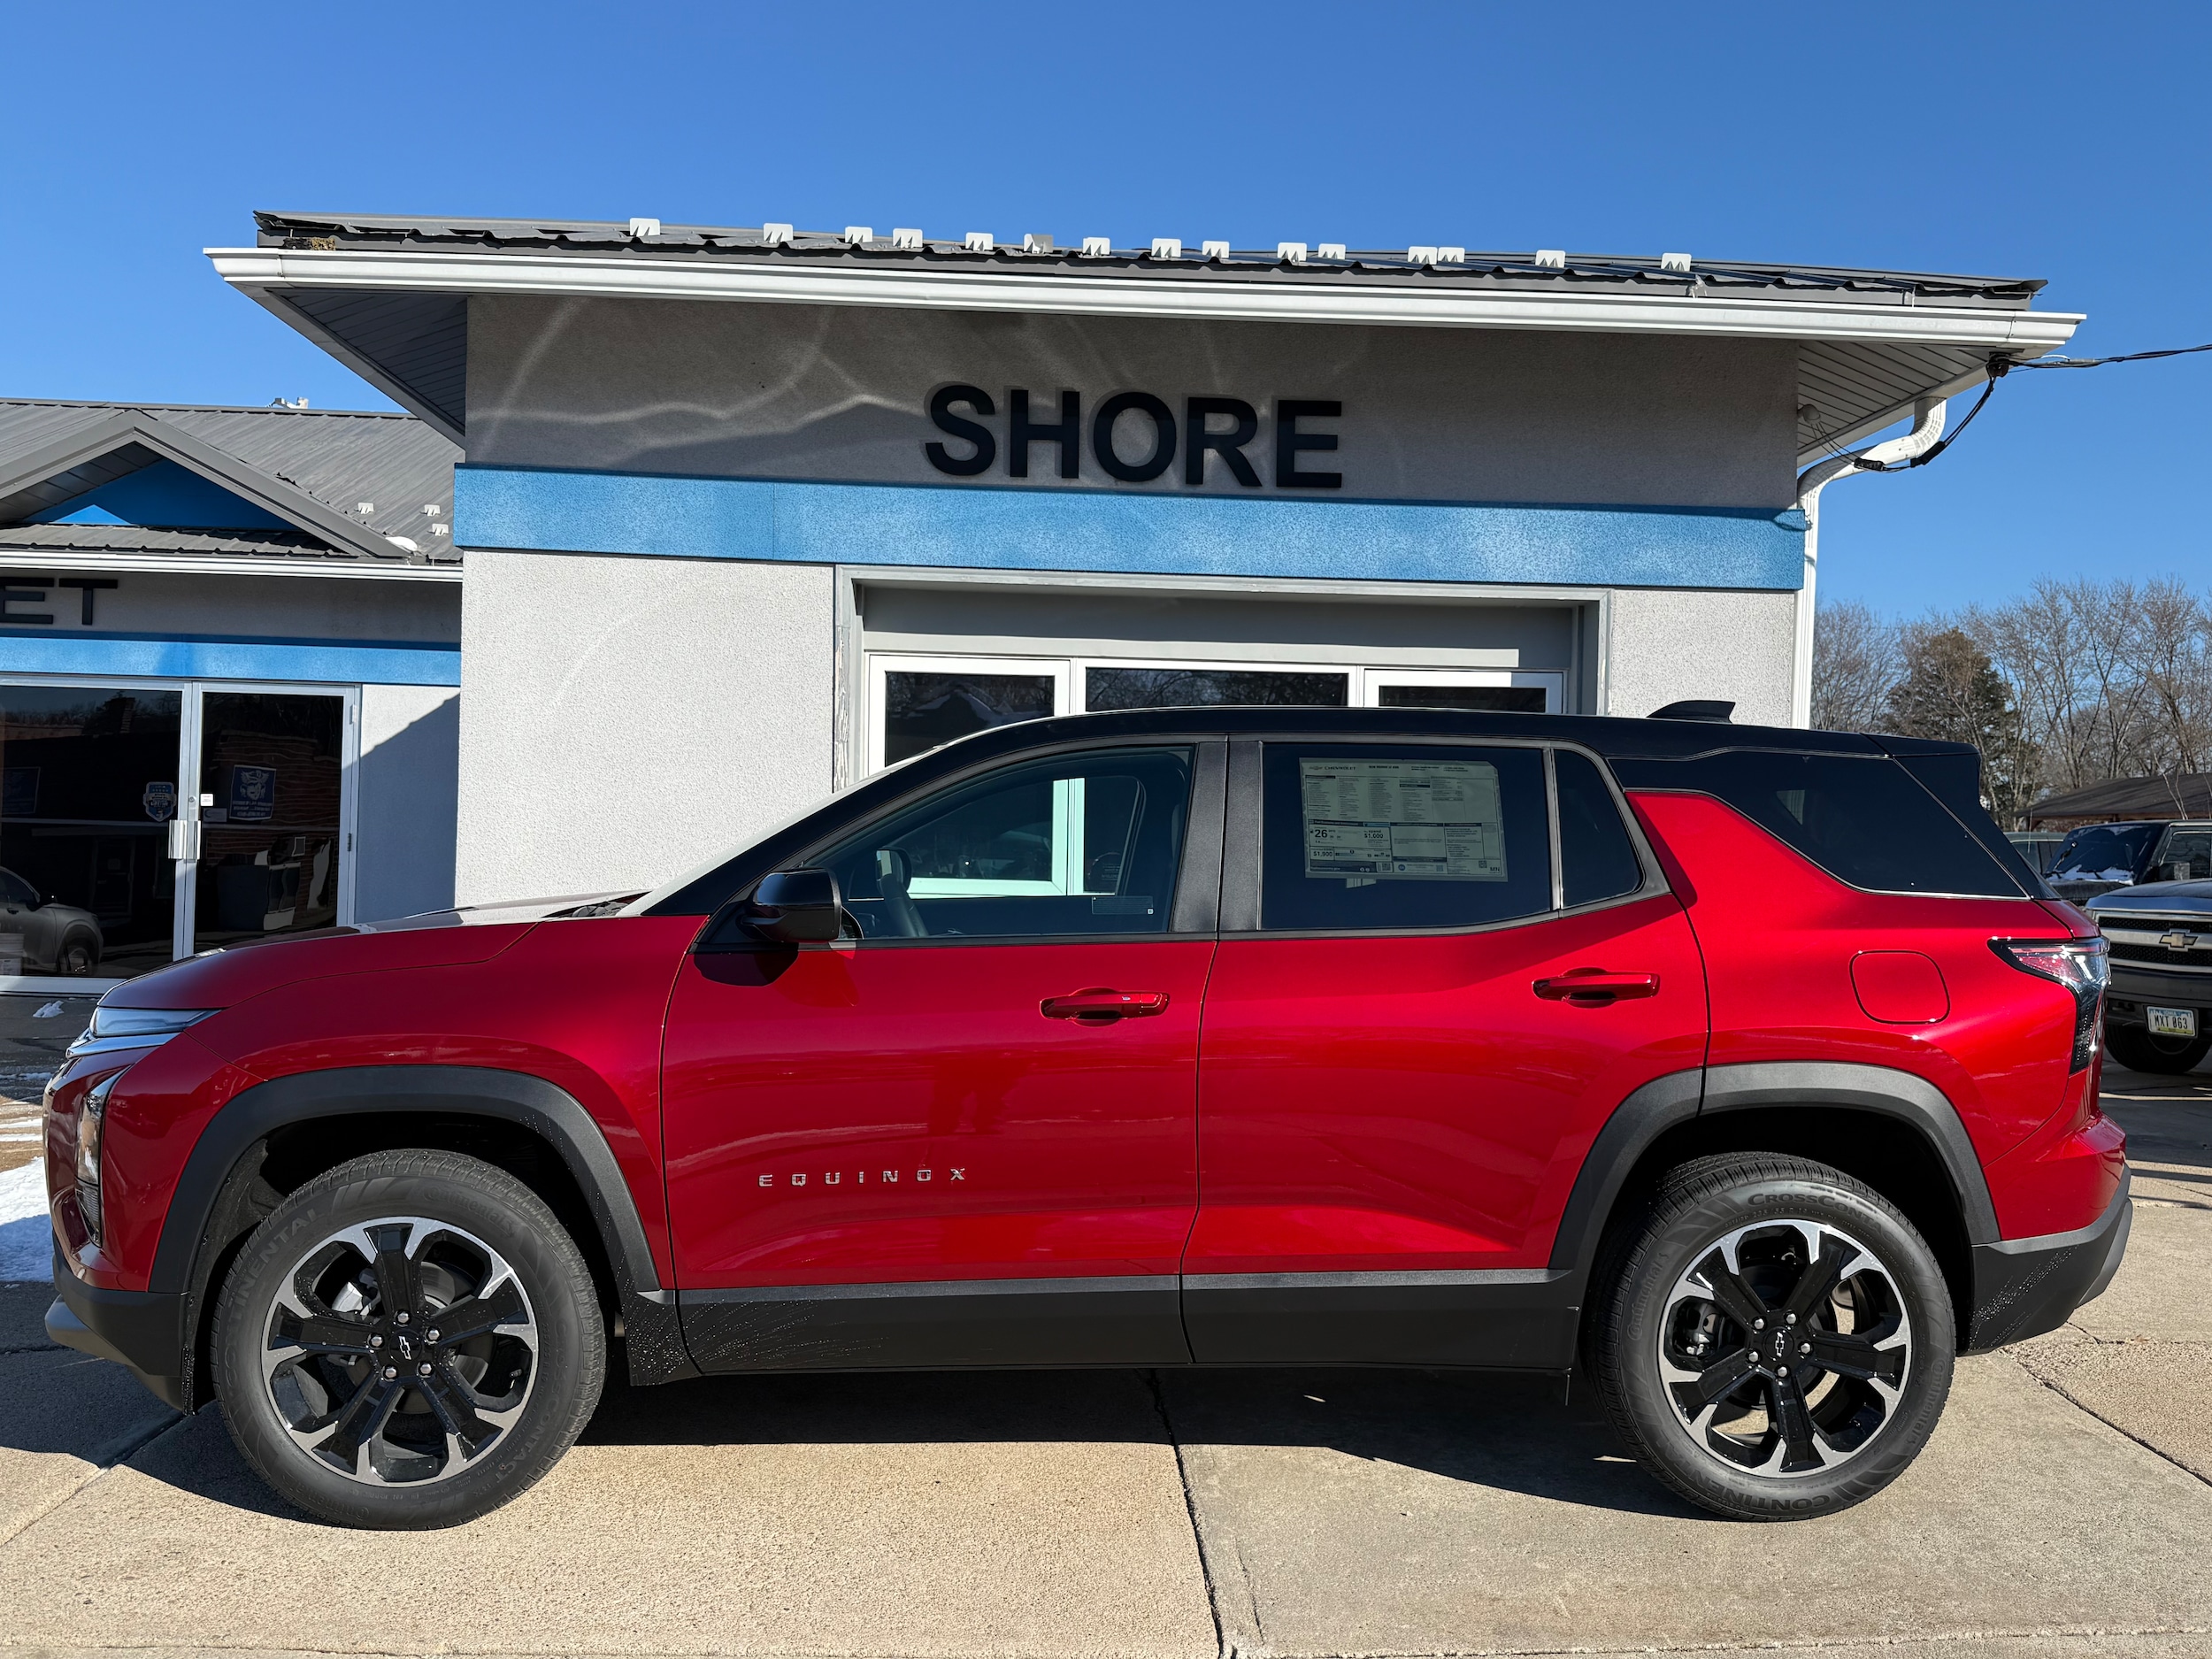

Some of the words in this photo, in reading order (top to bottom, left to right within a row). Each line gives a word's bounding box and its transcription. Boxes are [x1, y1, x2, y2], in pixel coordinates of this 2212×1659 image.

[926, 385, 1342, 488] SHORE
[0, 576, 118, 626] ET
[1314, 829, 1328, 838] 26
[758, 1167, 965, 1187] EQUINOX
